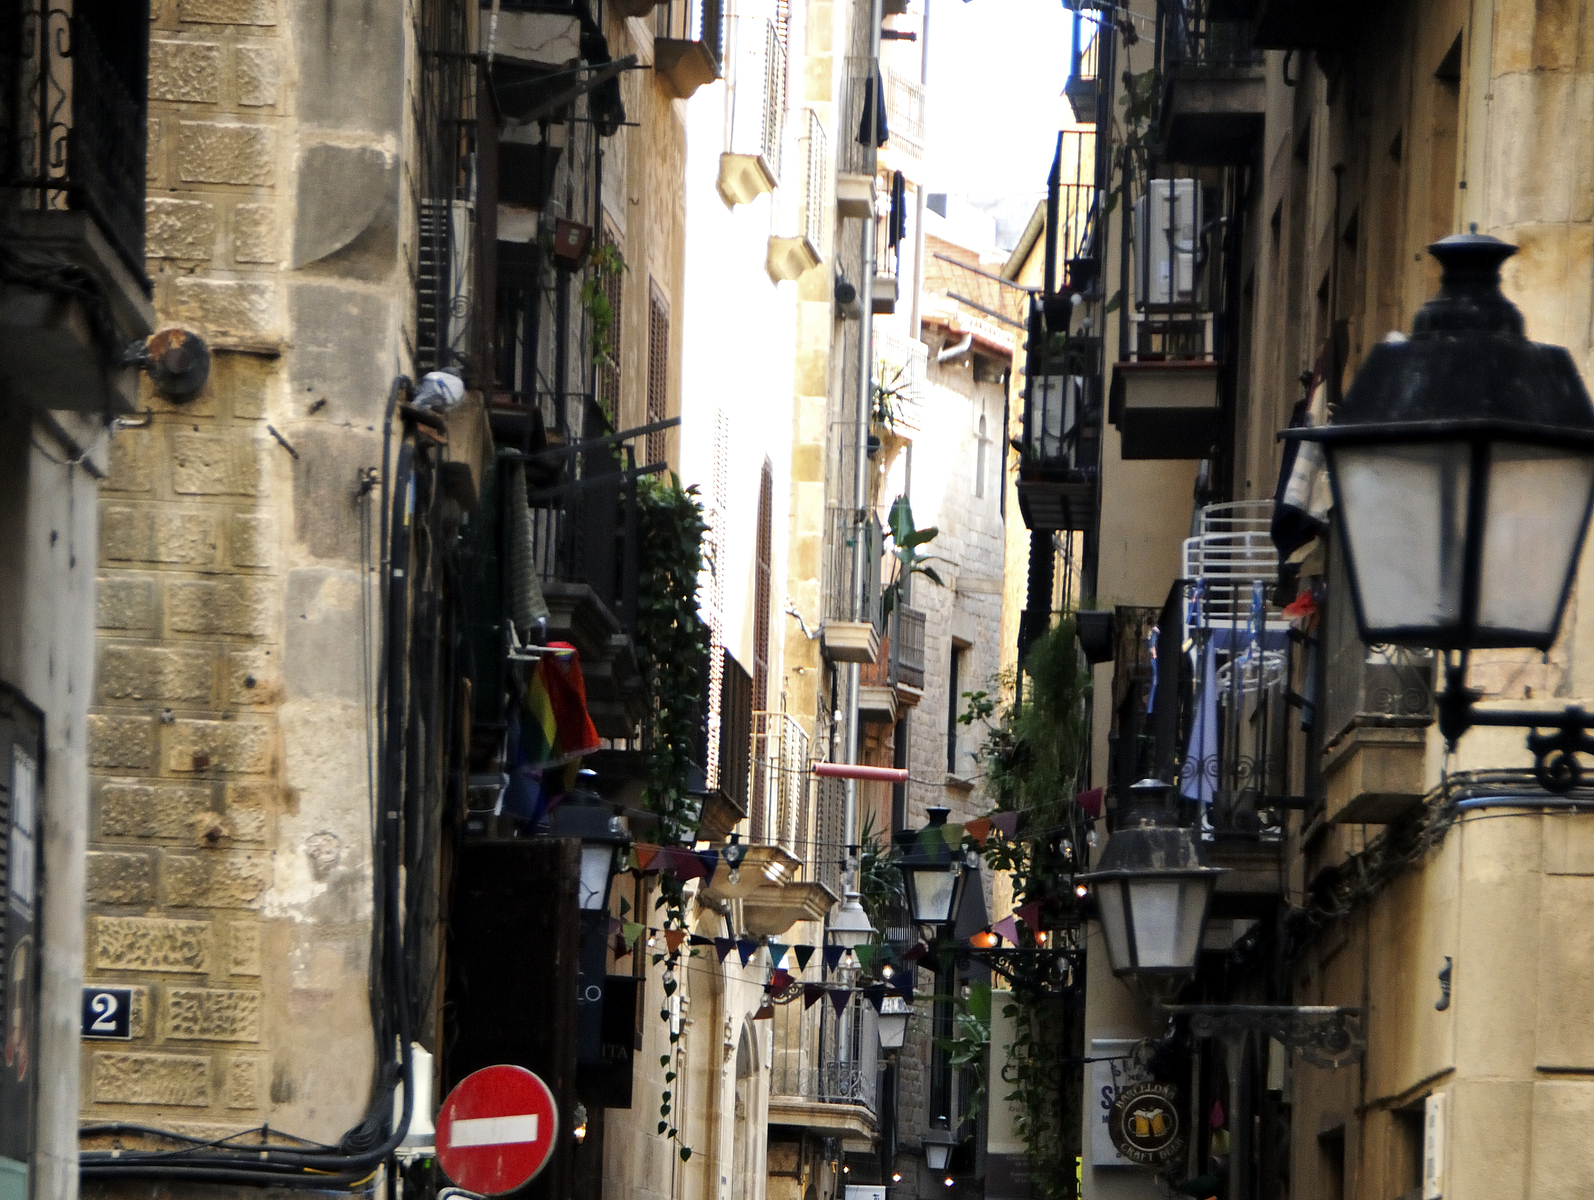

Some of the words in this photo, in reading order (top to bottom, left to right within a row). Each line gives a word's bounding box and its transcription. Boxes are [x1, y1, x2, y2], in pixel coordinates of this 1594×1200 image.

[80, 992, 119, 1030] 2
[1115, 1083, 1176, 1109] BARCELONA
[1121, 1143, 1153, 1162] CRAFT
[1159, 1136, 1184, 1160] BEER
